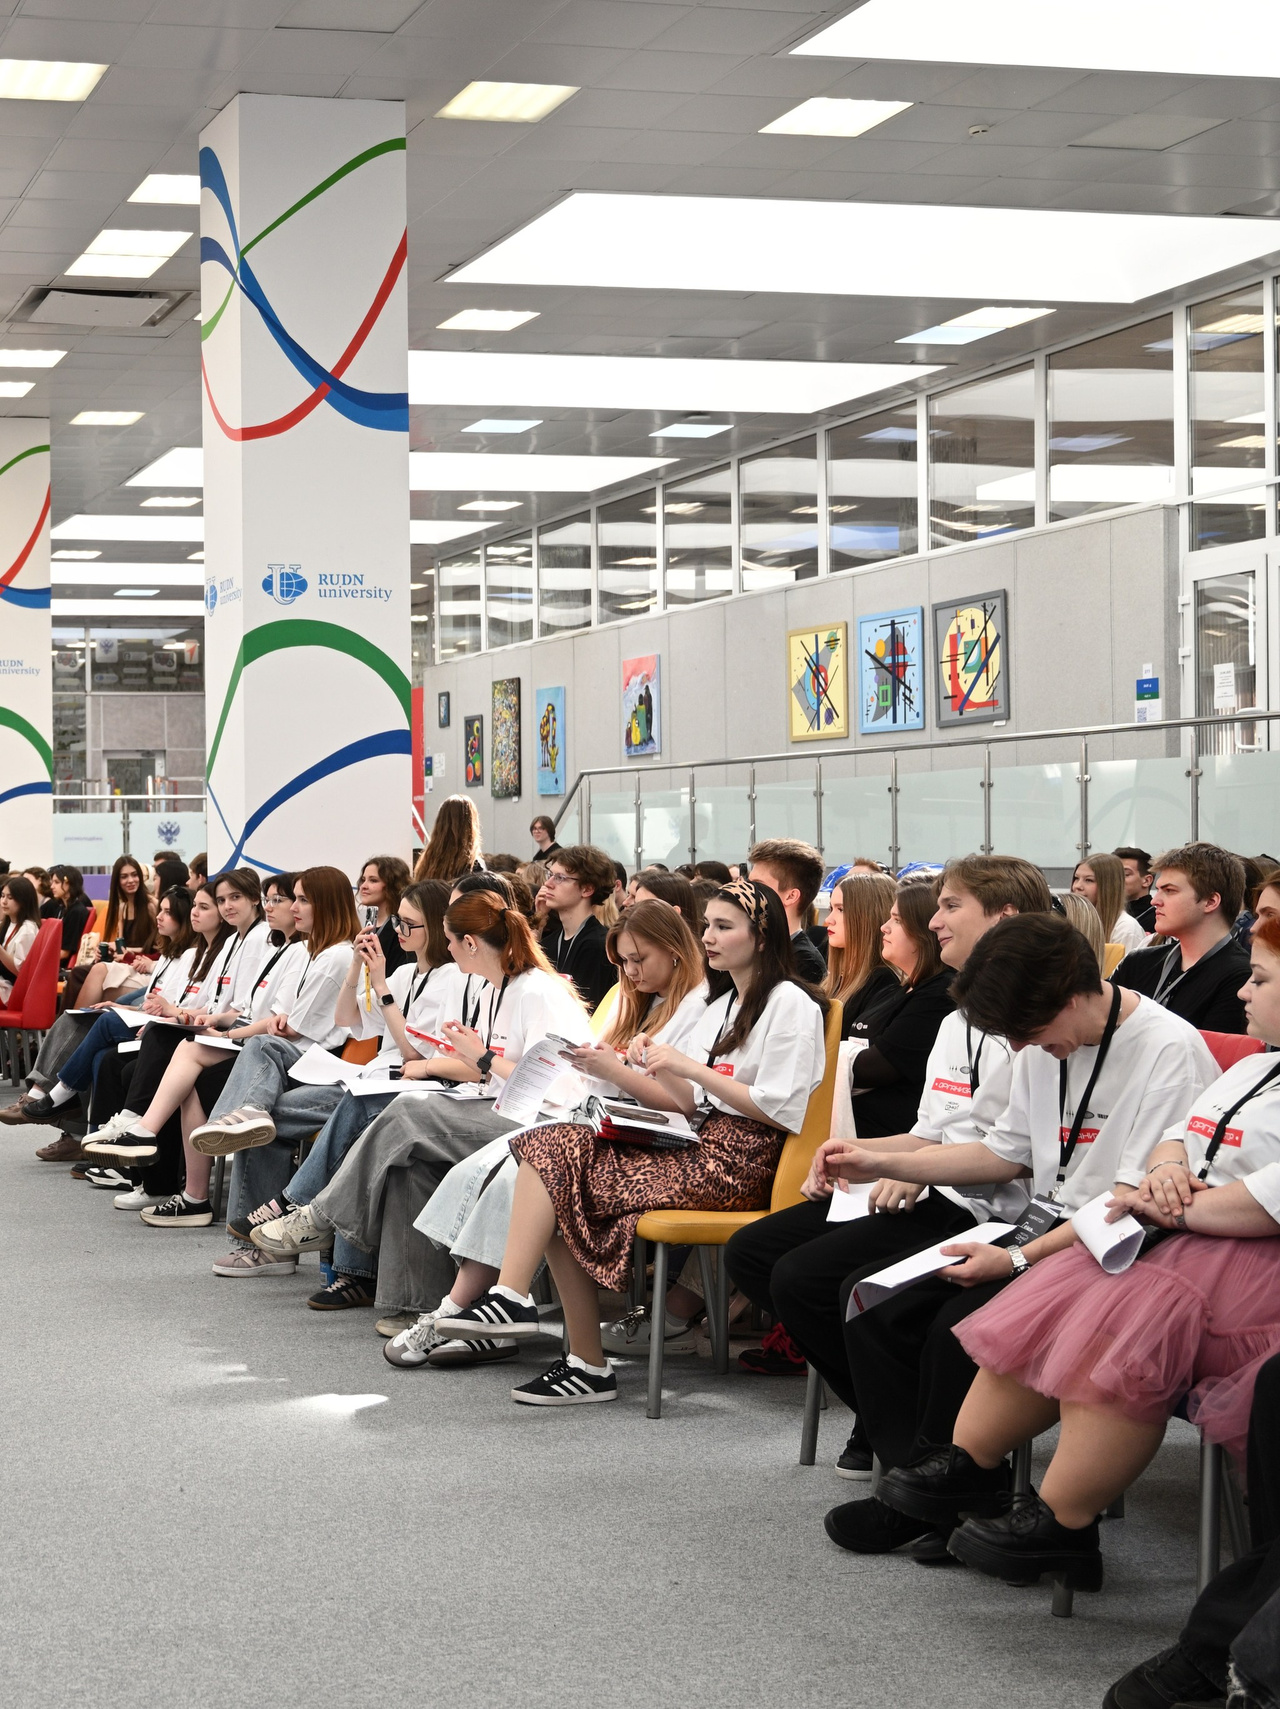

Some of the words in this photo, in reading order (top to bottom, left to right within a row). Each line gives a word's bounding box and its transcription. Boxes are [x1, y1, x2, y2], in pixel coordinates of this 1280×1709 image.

[318, 574, 365, 586] RUDN
[318, 586, 393, 602] university
[938, 1082, 971, 1094] ОРГАНИЗА
